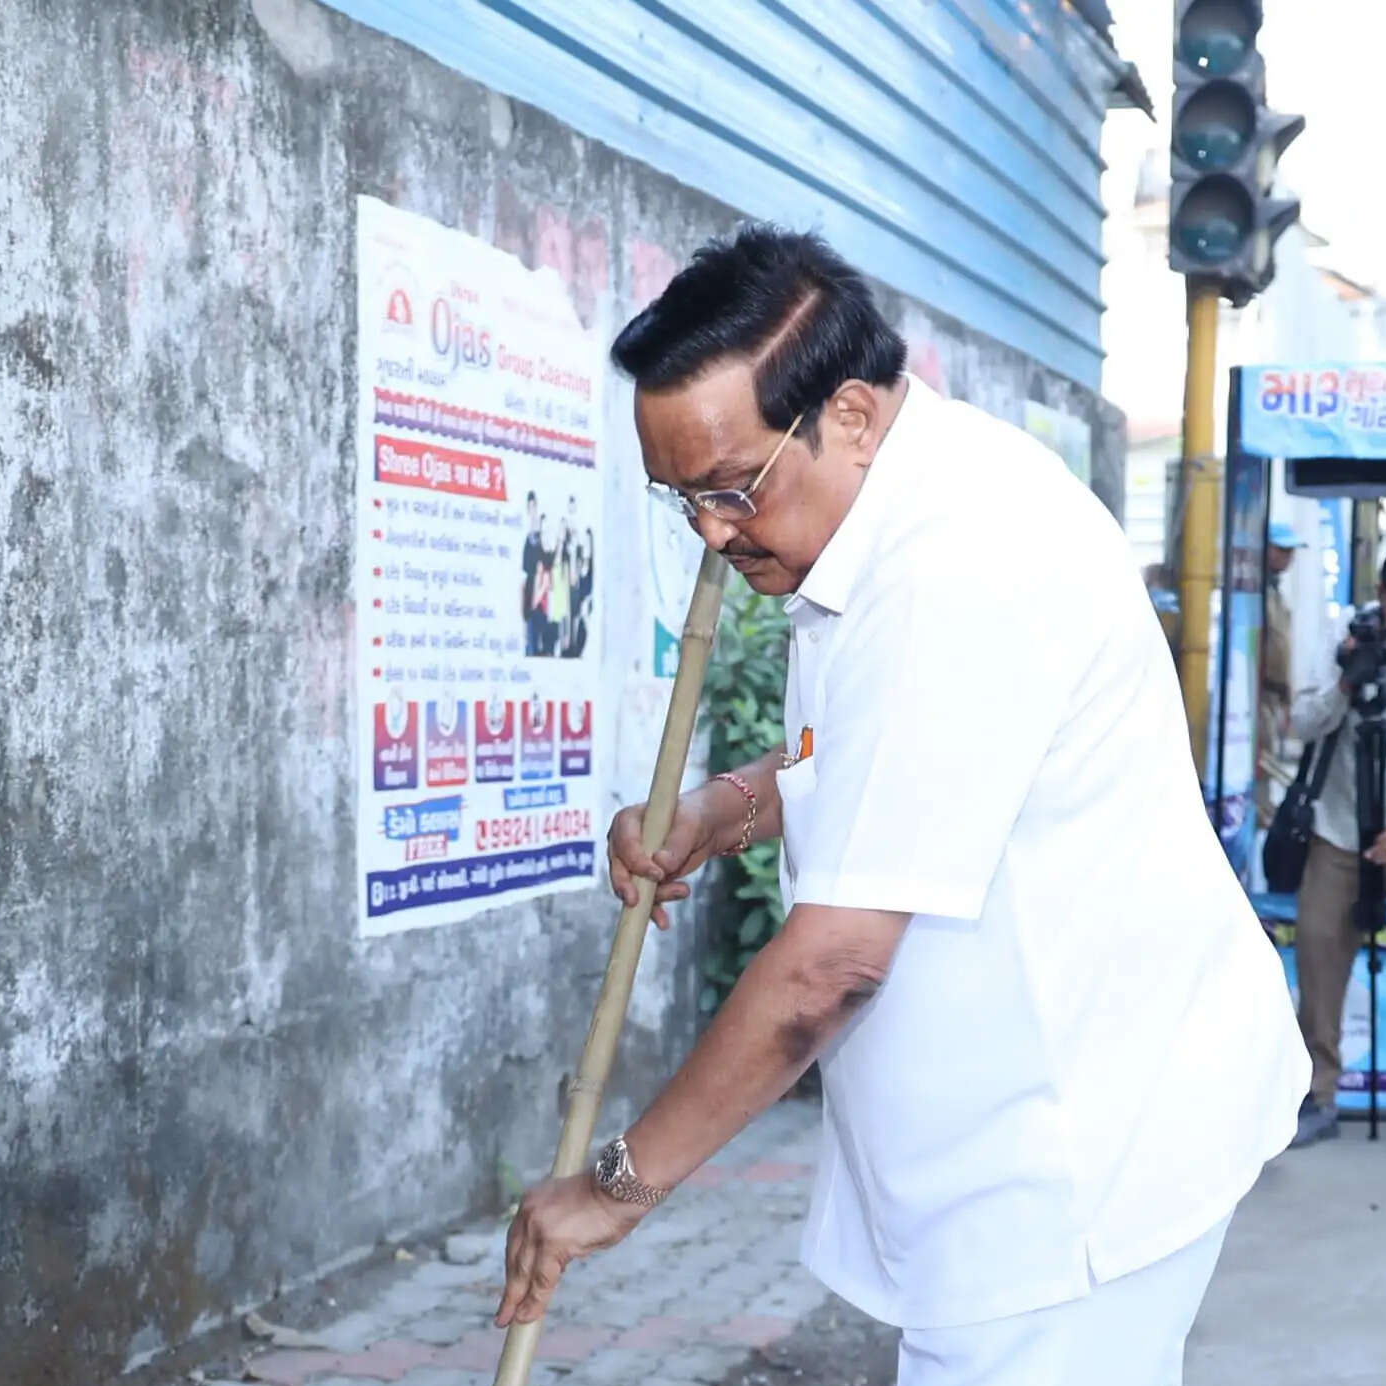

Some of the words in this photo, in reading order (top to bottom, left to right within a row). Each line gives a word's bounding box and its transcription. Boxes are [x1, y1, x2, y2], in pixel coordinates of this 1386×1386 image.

[431, 298, 492, 371] Ojas
[379, 444, 420, 476] Shree
[421, 451, 452, 487] Ojas
